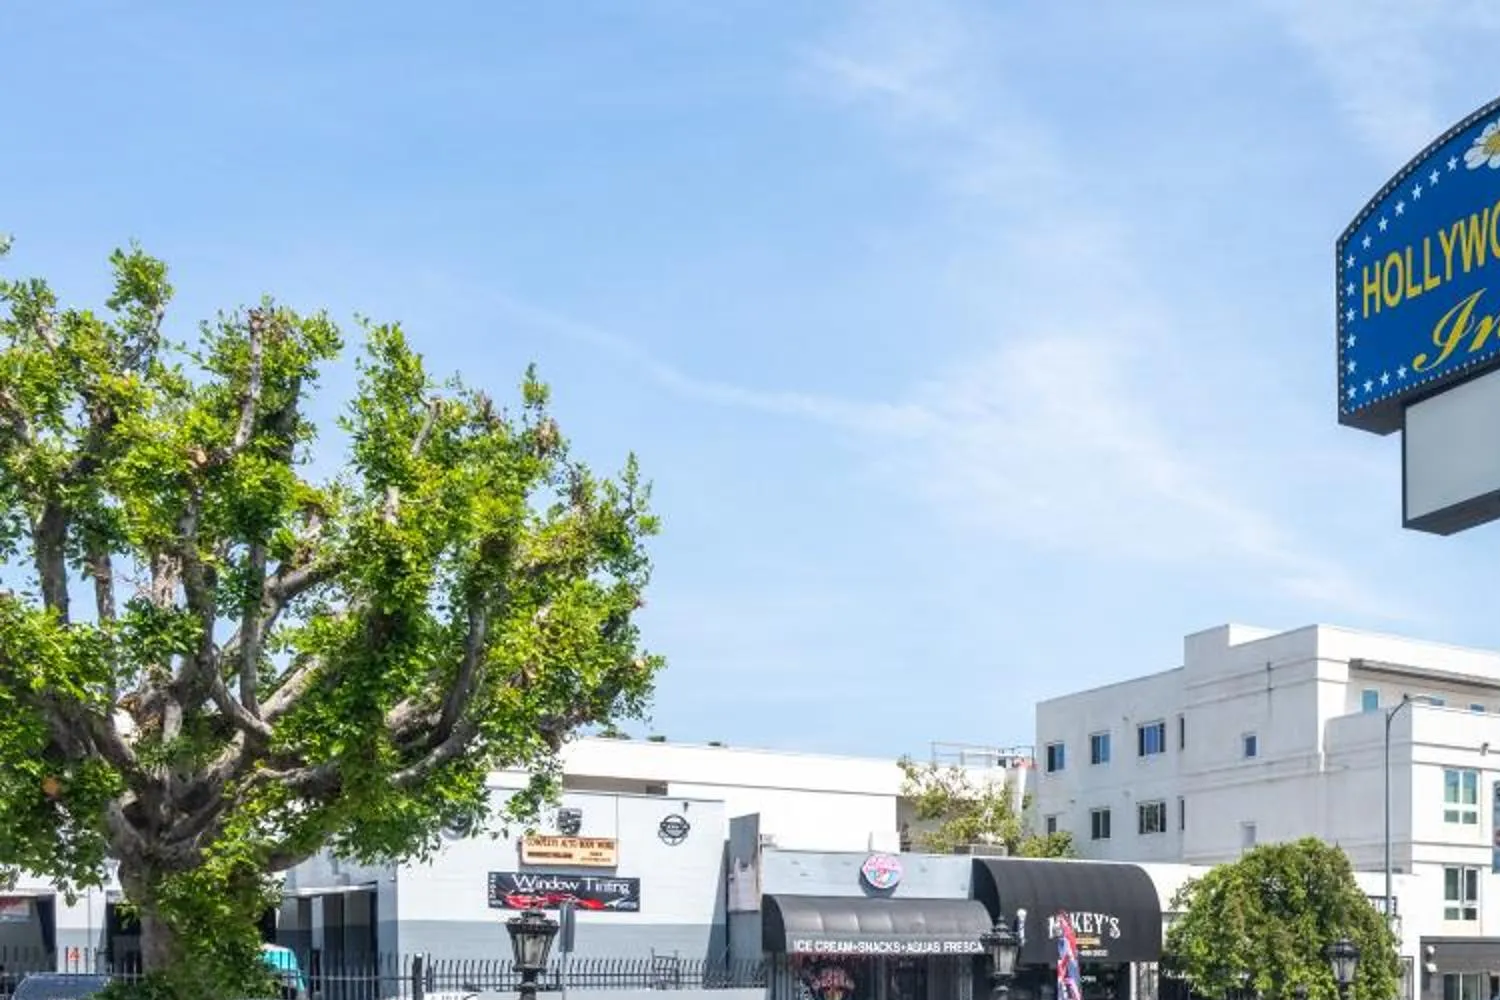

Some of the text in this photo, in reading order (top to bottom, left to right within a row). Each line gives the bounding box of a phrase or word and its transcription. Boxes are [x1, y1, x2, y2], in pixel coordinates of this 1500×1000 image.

[511, 874, 580, 891] Window
[1048, 911, 1121, 939] MKEY'S
[793, 939, 813, 952] ICE
[815, 940, 853, 952] CREAM
